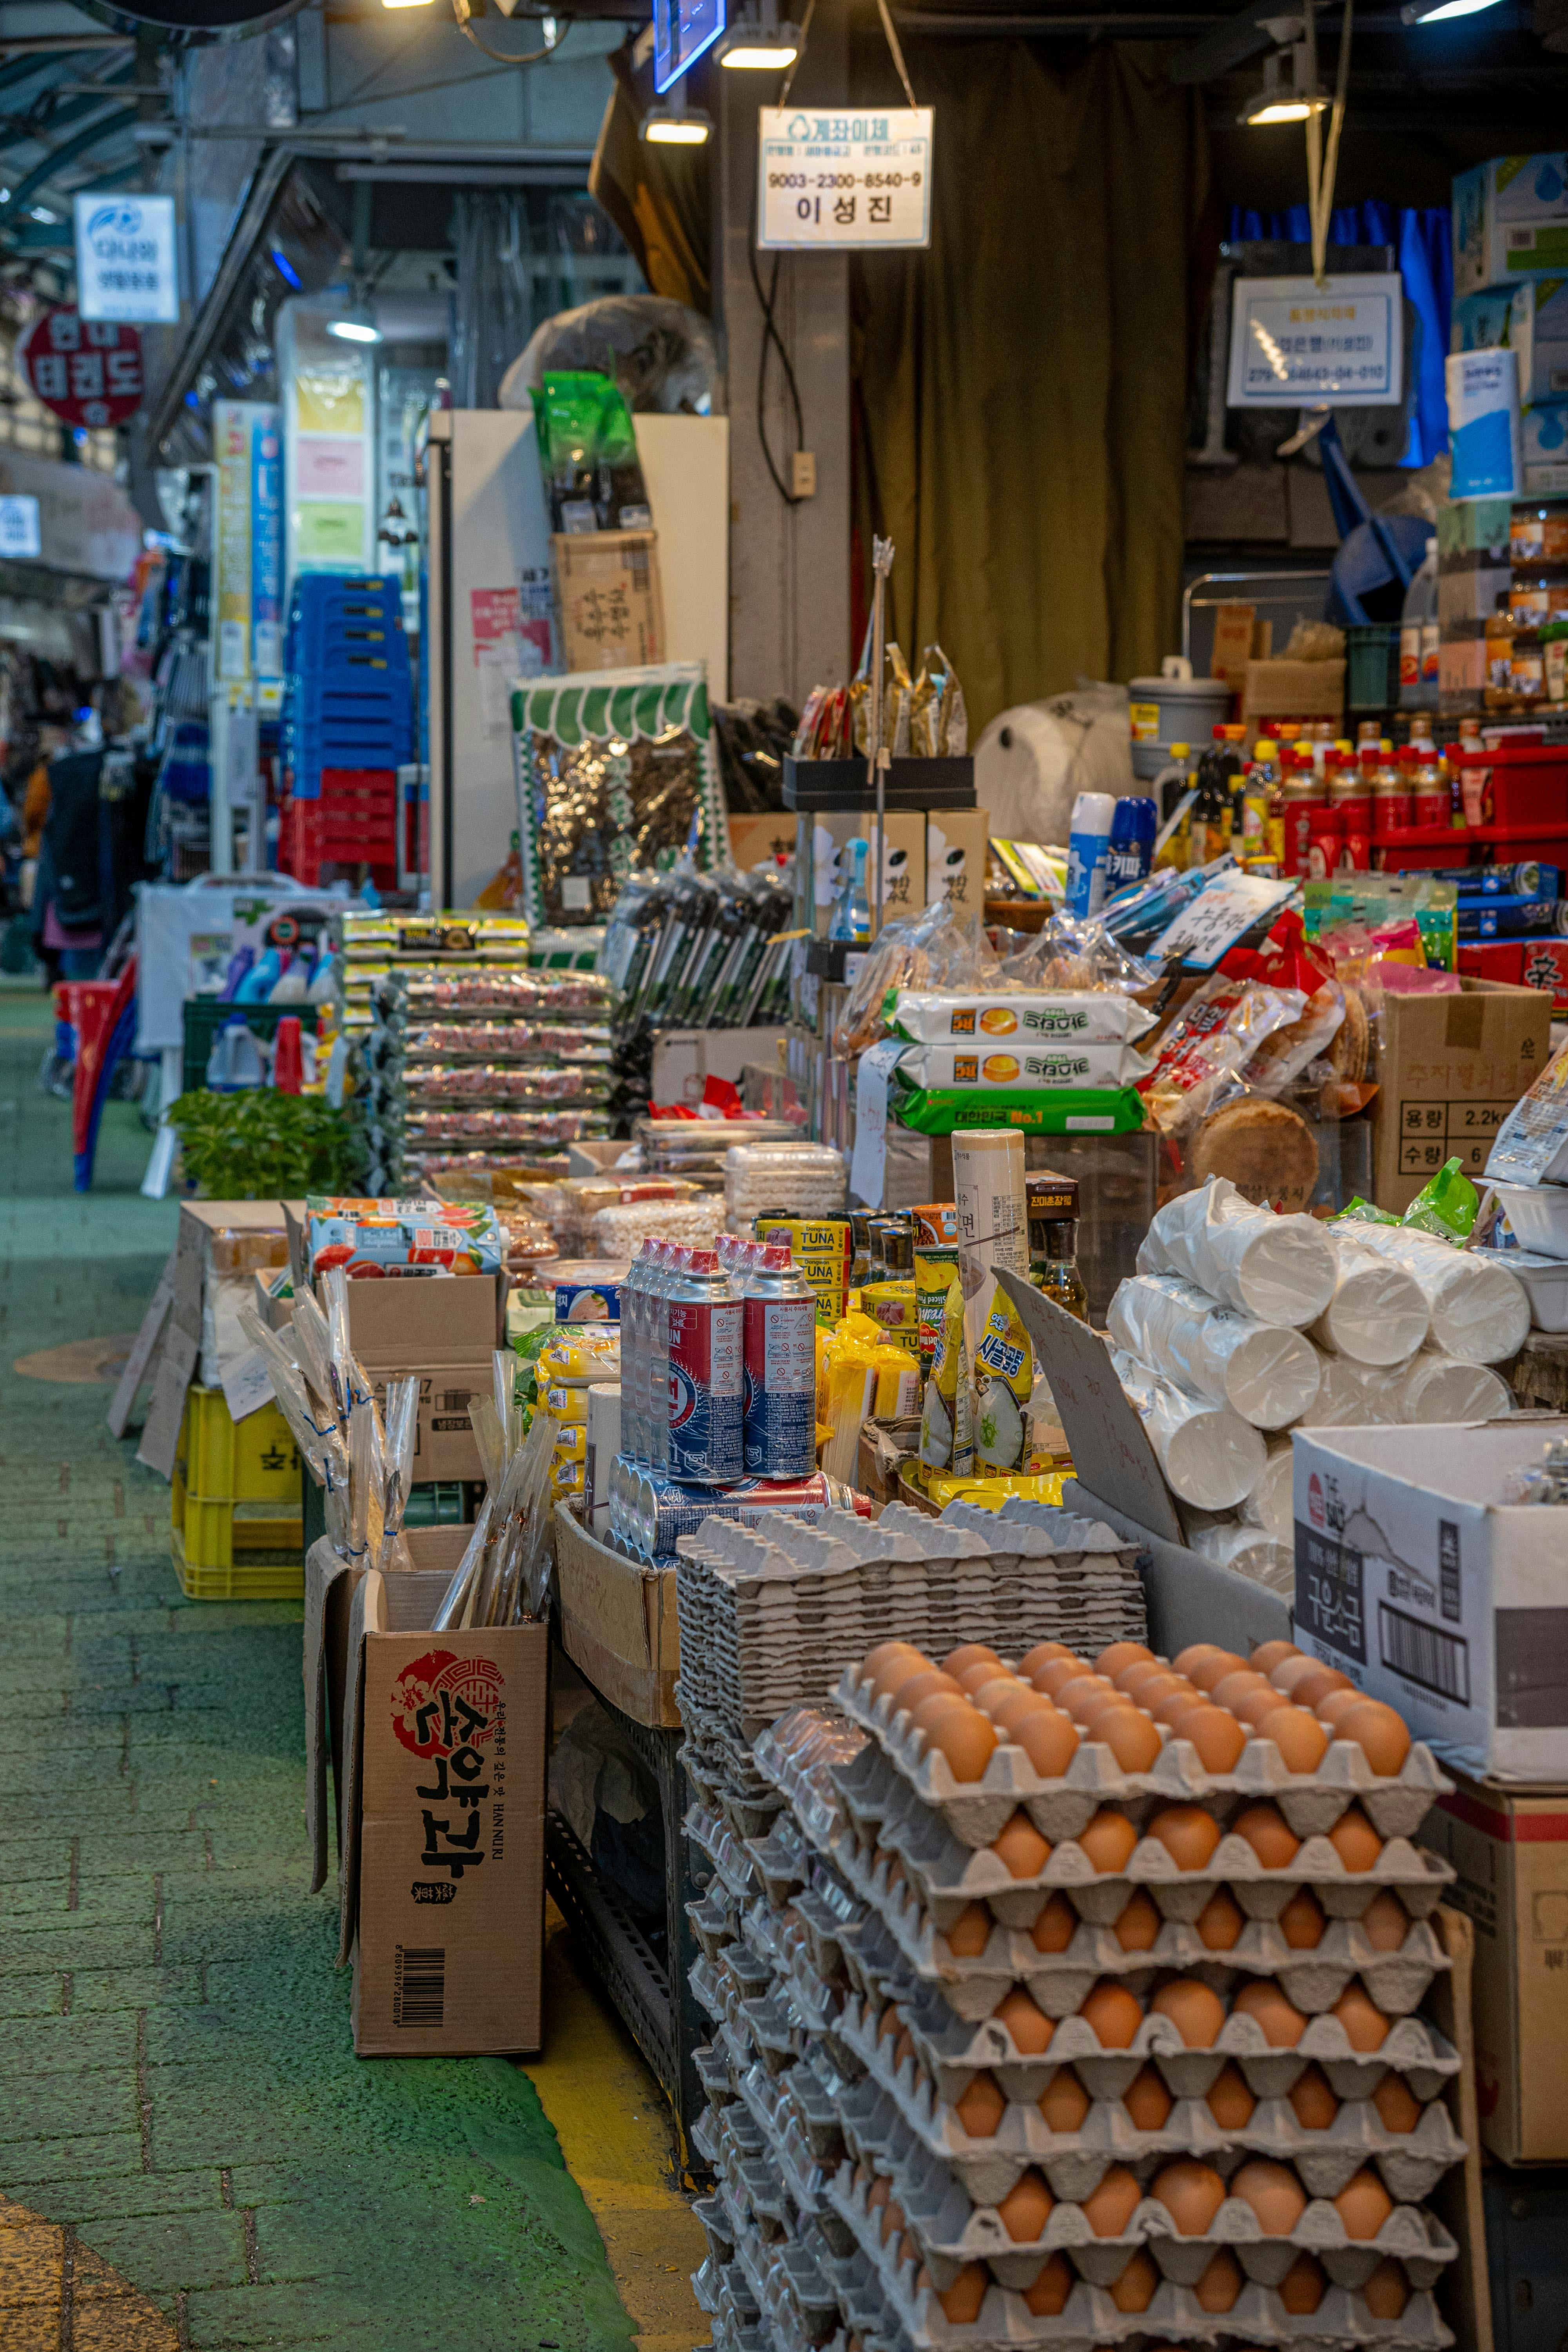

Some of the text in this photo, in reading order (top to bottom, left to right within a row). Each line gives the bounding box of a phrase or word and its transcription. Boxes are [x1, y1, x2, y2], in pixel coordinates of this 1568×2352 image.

[812, 118, 888, 141] 계좌이체
[955, 1111, 1043, 1124] 대한민국 No.1
[1405, 1110, 1442, 1128] 용량
[1405, 1146, 1481, 1165] 수량 6
[800, 1232, 835, 1244] TUNA
[816, 1298, 833, 1310] NA
[927, 1296, 946, 1305] Sliced
[991, 1312, 1005, 1332] 옛날
[668, 1329, 681, 1344] UN
[900, 1336, 920, 1348] TU
[980, 1333, 1026, 1378] 사골곰탕
[746, 1447, 760, 1457] TSR
[1309, 1574, 1361, 1648] 구운소금
[494, 1700, 506, 1721] 우리
[494, 1726, 506, 1756] 전통의
[493, 1761, 506, 1782] 깊은
[415, 1690, 490, 1879] 손약과
[493, 1786, 506, 1797] 맛
[394, 1953, 403, 1987] 809396
[392, 1991, 402, 2025] 280018
